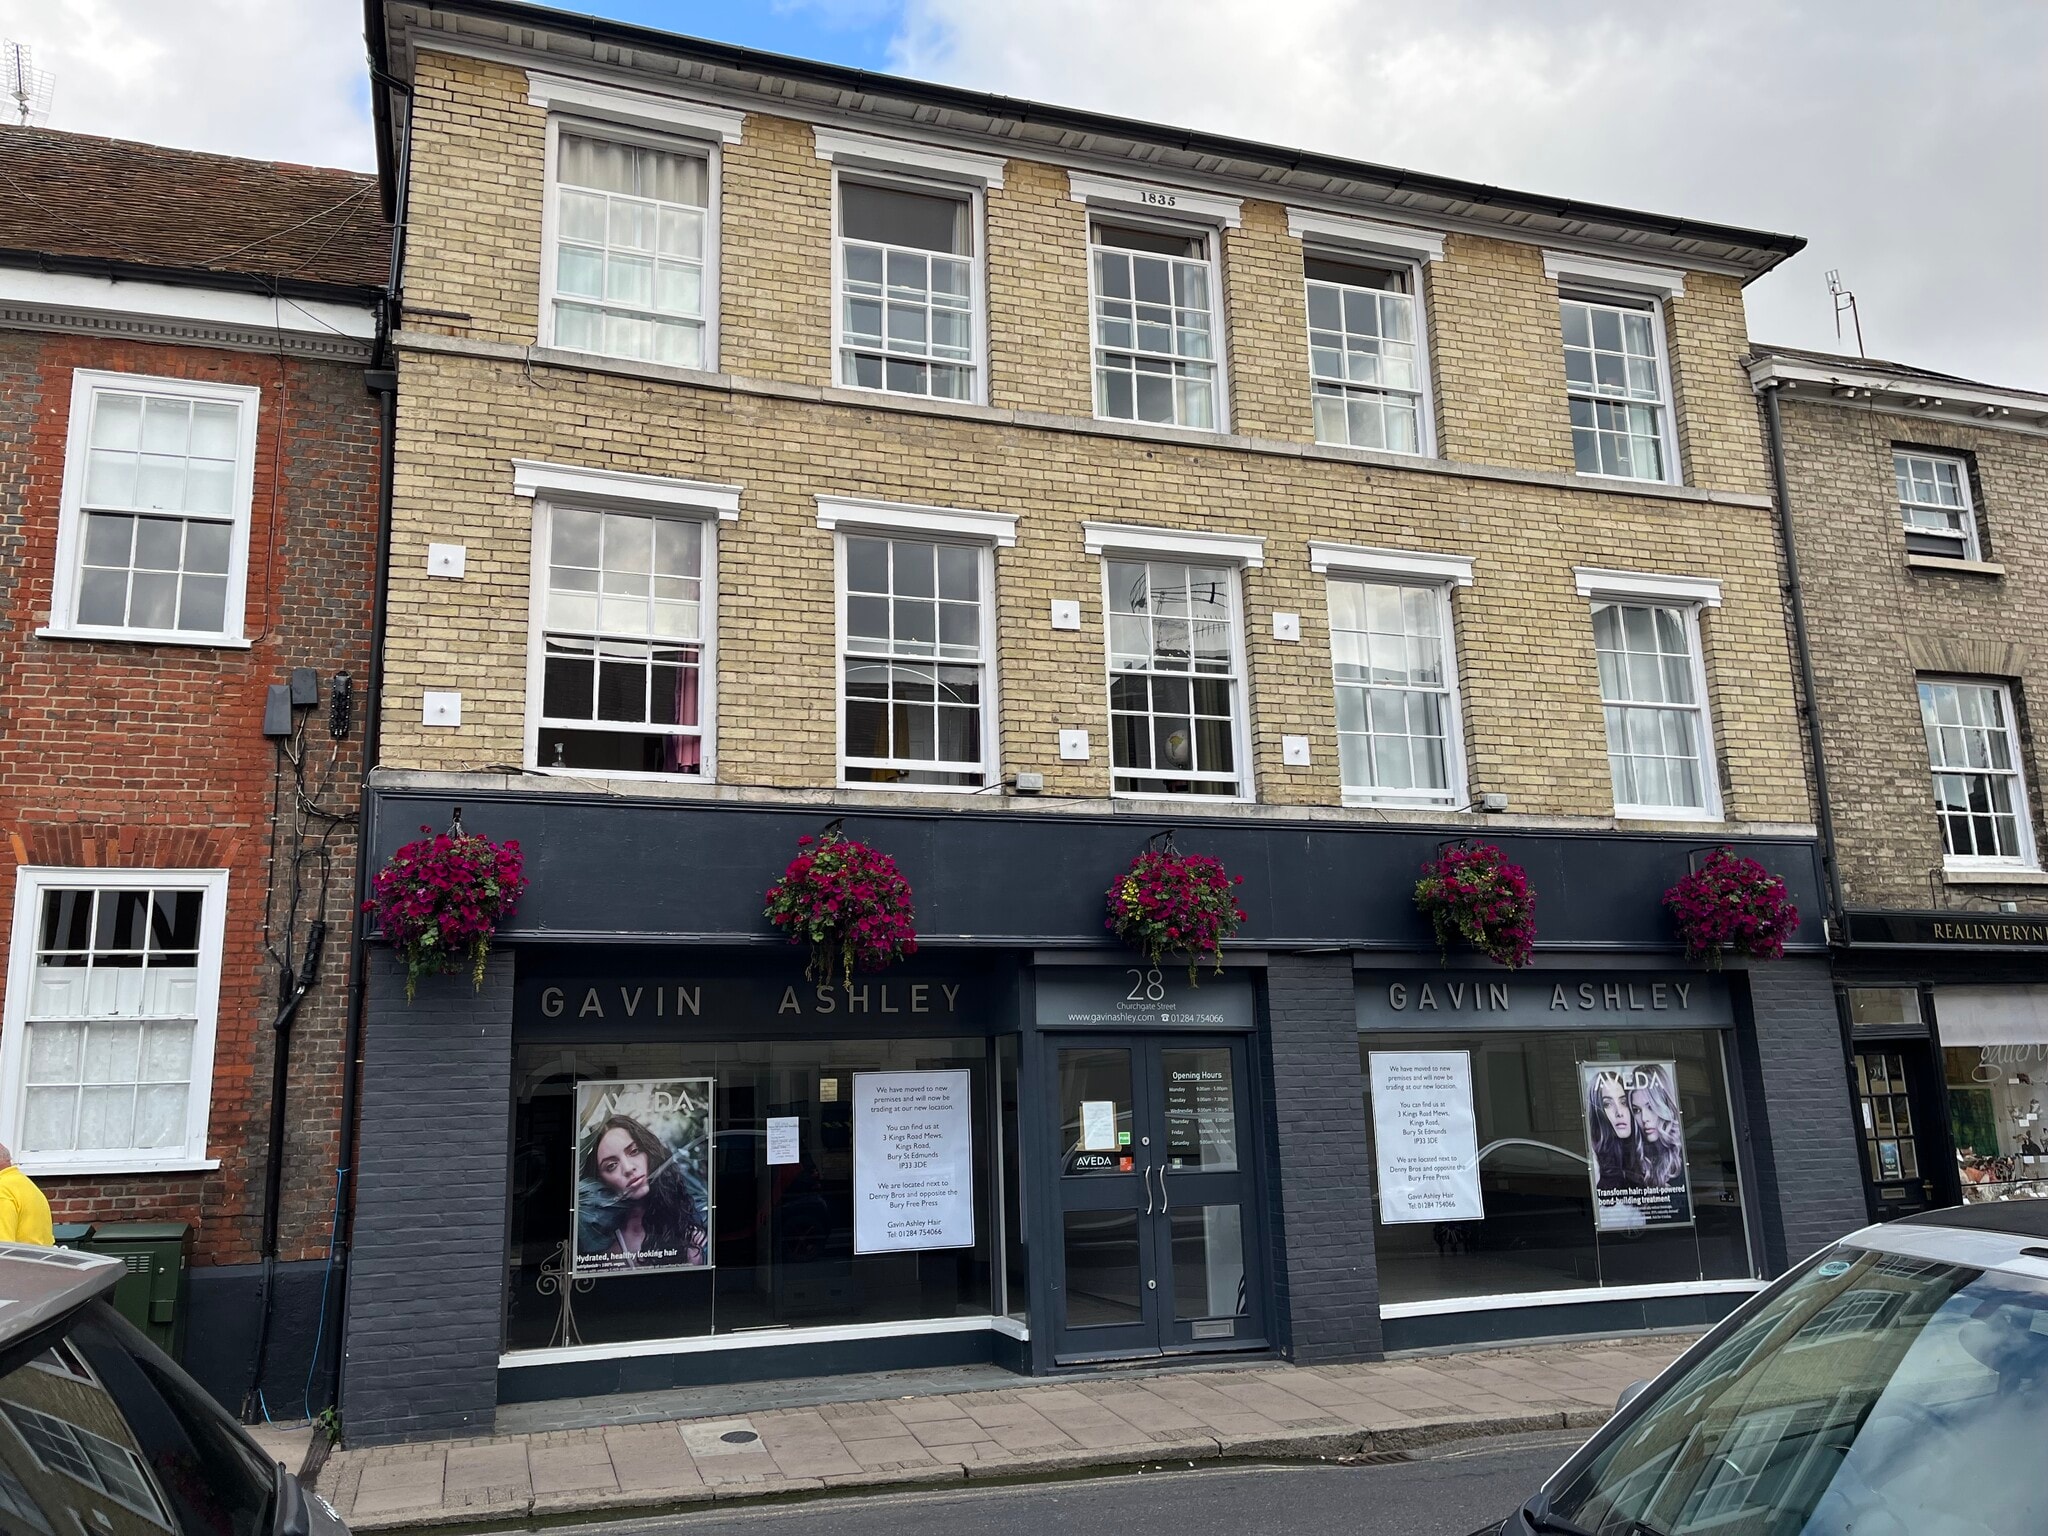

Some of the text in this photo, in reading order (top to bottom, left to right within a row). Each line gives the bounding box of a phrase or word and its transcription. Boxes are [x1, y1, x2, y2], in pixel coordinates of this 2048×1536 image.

[1141, 192, 1176, 207] 1835
[1126, 969, 1165, 1001] 28
[540, 983, 961, 1018] GAVIN ASHLEY
[1389, 983, 1691, 1010] GAVIN ASHLEY
[1116, 1002, 1177, 1012] Churchgate Street
[1068, 1012, 1224, 1024] www.gavinashley.com 01284 754066
[1172, 1071, 1222, 1080] Opening Hours
[1594, 1071, 1665, 1092] AVEDA
[592, 1090, 695, 1115] AVDA
[889, 1134, 905, 1142] Kings
[887, 1153, 902, 1161] Bury
[1076, 1156, 1112, 1166] AVEDA
[1389, 1166, 1408, 1174] Denny
[1597, 1184, 1685, 1197] Transform hair: plant-powered
[1598, 1195, 1671, 1206] bond-building treatment
[906, 1220, 926, 1228] Ashley
[576, 1248, 678, 1263] Hydrated, healthy looking hair
